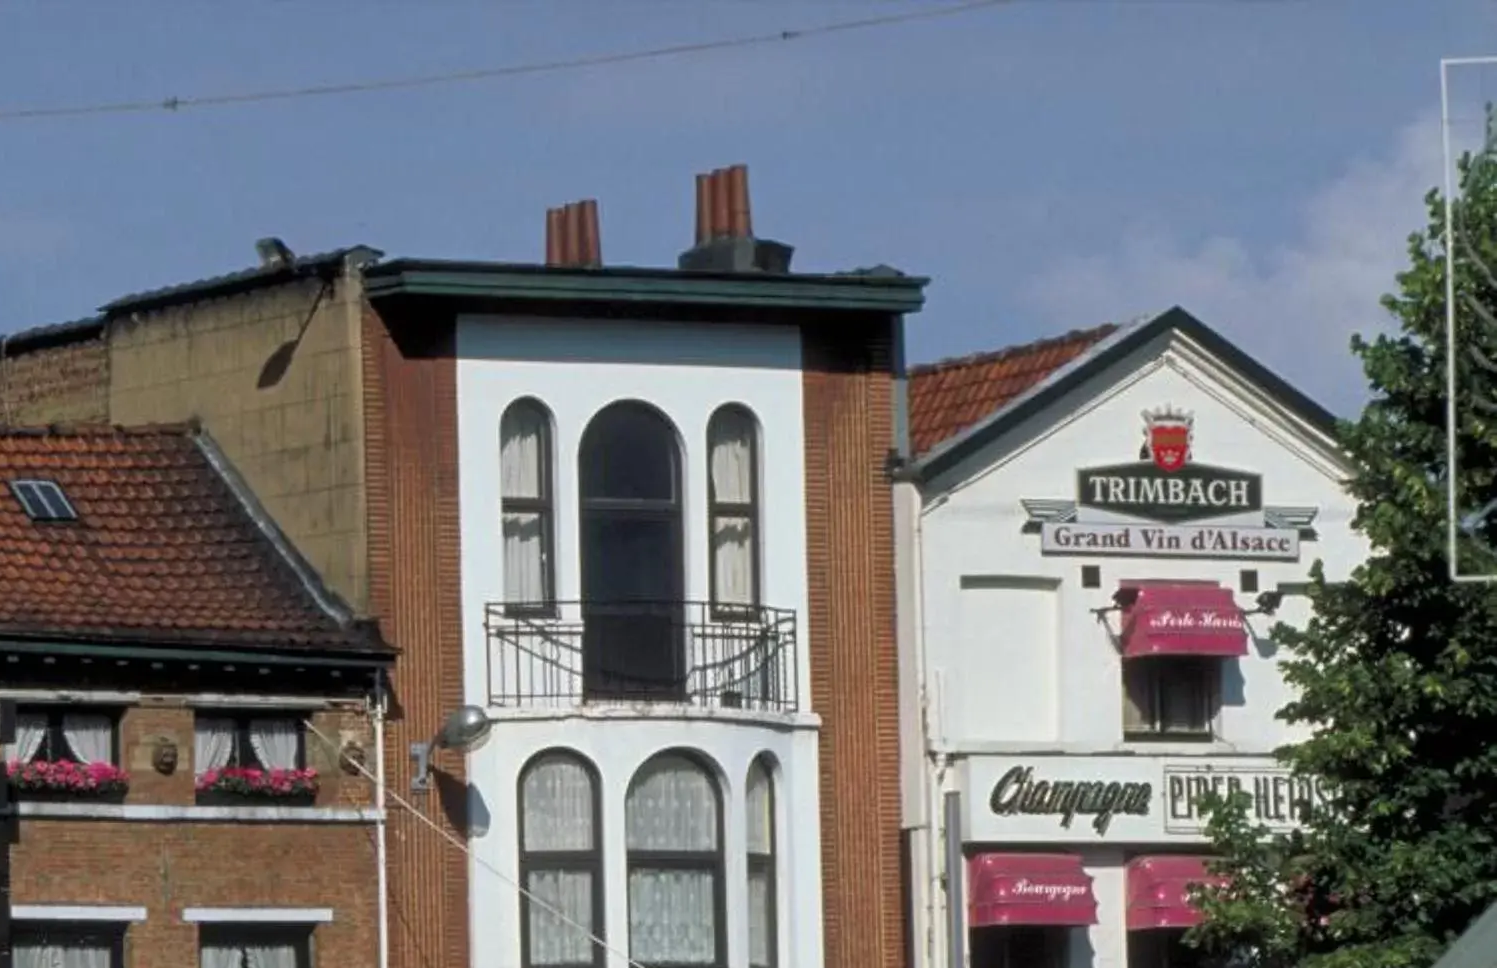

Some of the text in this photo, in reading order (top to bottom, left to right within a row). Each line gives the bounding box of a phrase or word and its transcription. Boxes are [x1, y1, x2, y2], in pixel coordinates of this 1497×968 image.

[1089, 476, 1250, 506] TRIMBACH
[1054, 526, 1291, 552] Grand Vin d'Alsace
[990, 765, 1153, 837] Champagne
[1253, 776, 1334, 828] HEIDS
